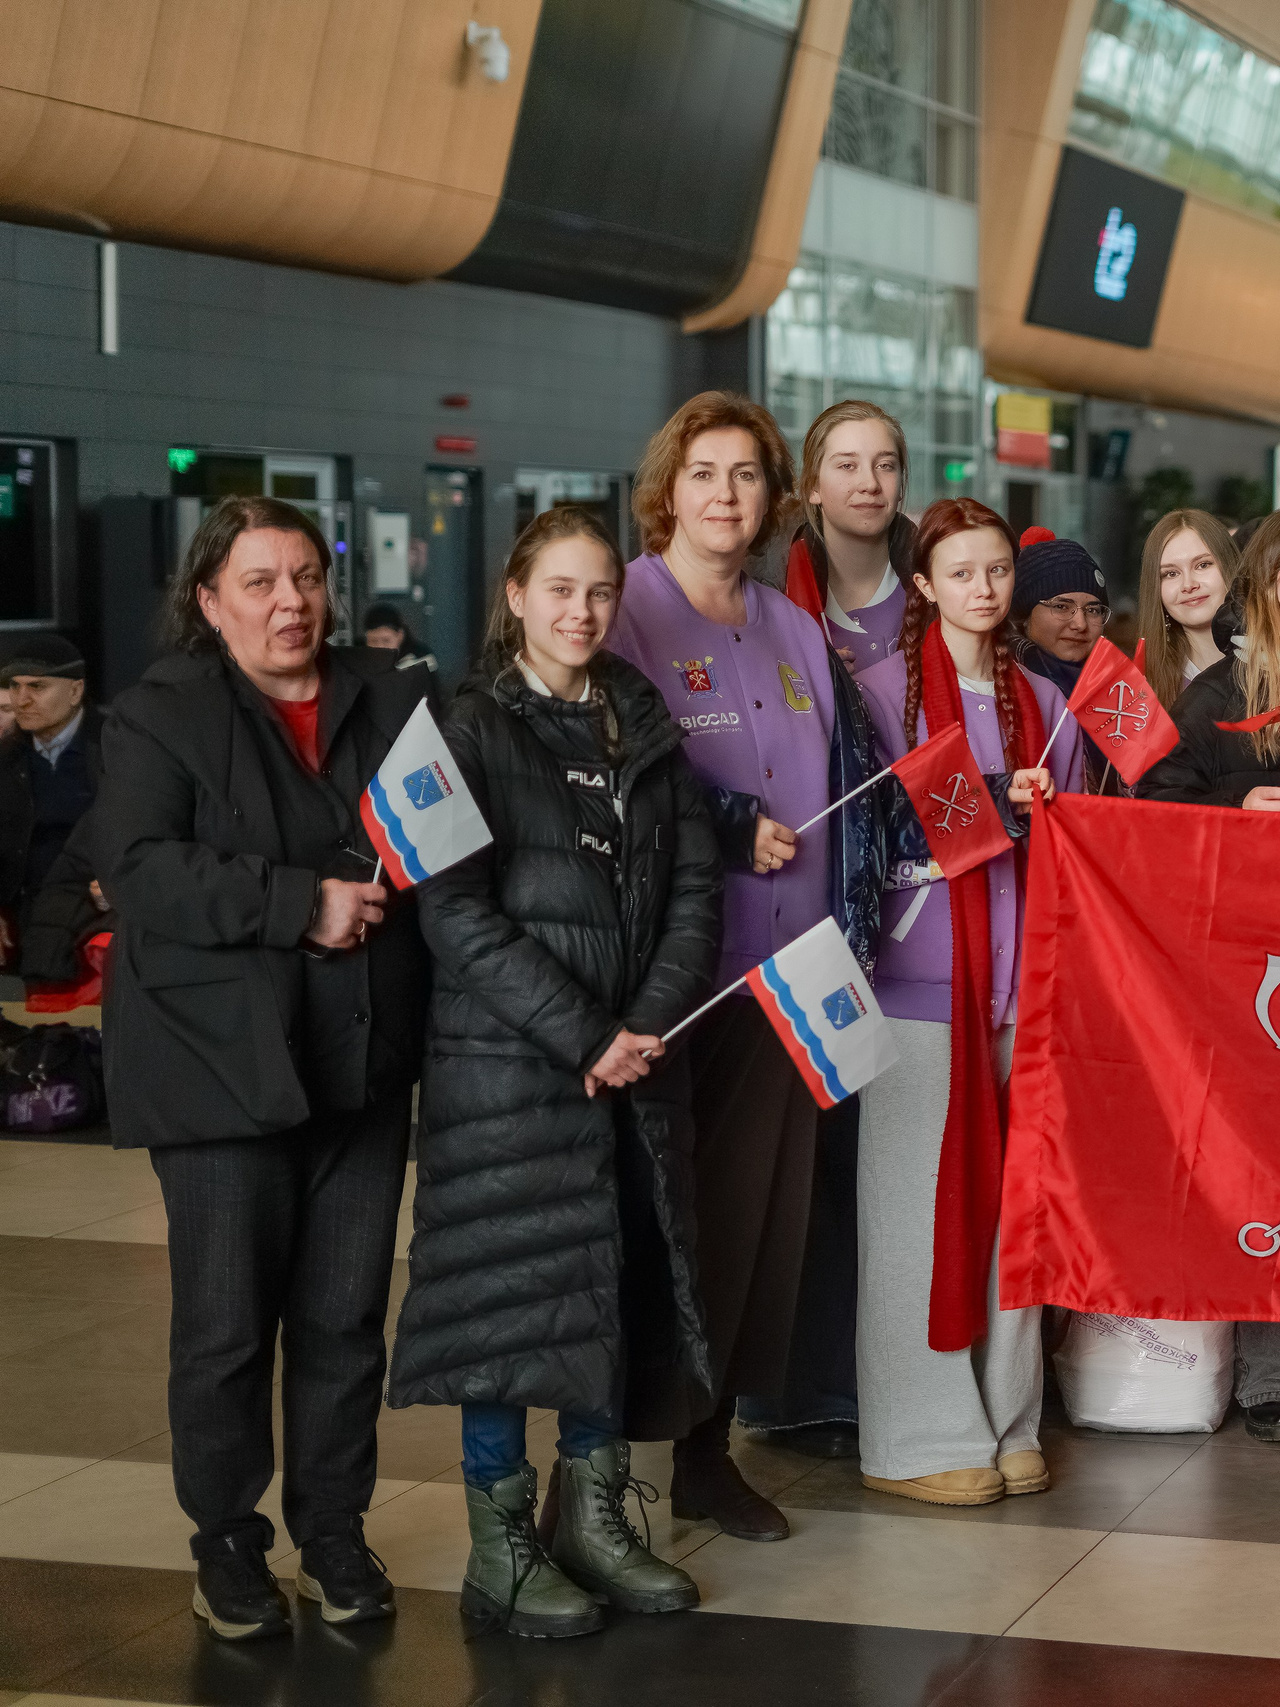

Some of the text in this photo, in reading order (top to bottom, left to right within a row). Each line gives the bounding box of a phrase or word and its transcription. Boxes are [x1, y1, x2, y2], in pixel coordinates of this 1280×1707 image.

[679, 712, 740, 729] BIOCAD
[567, 770, 606, 787] FILA
[581, 833, 612, 855] FILA
